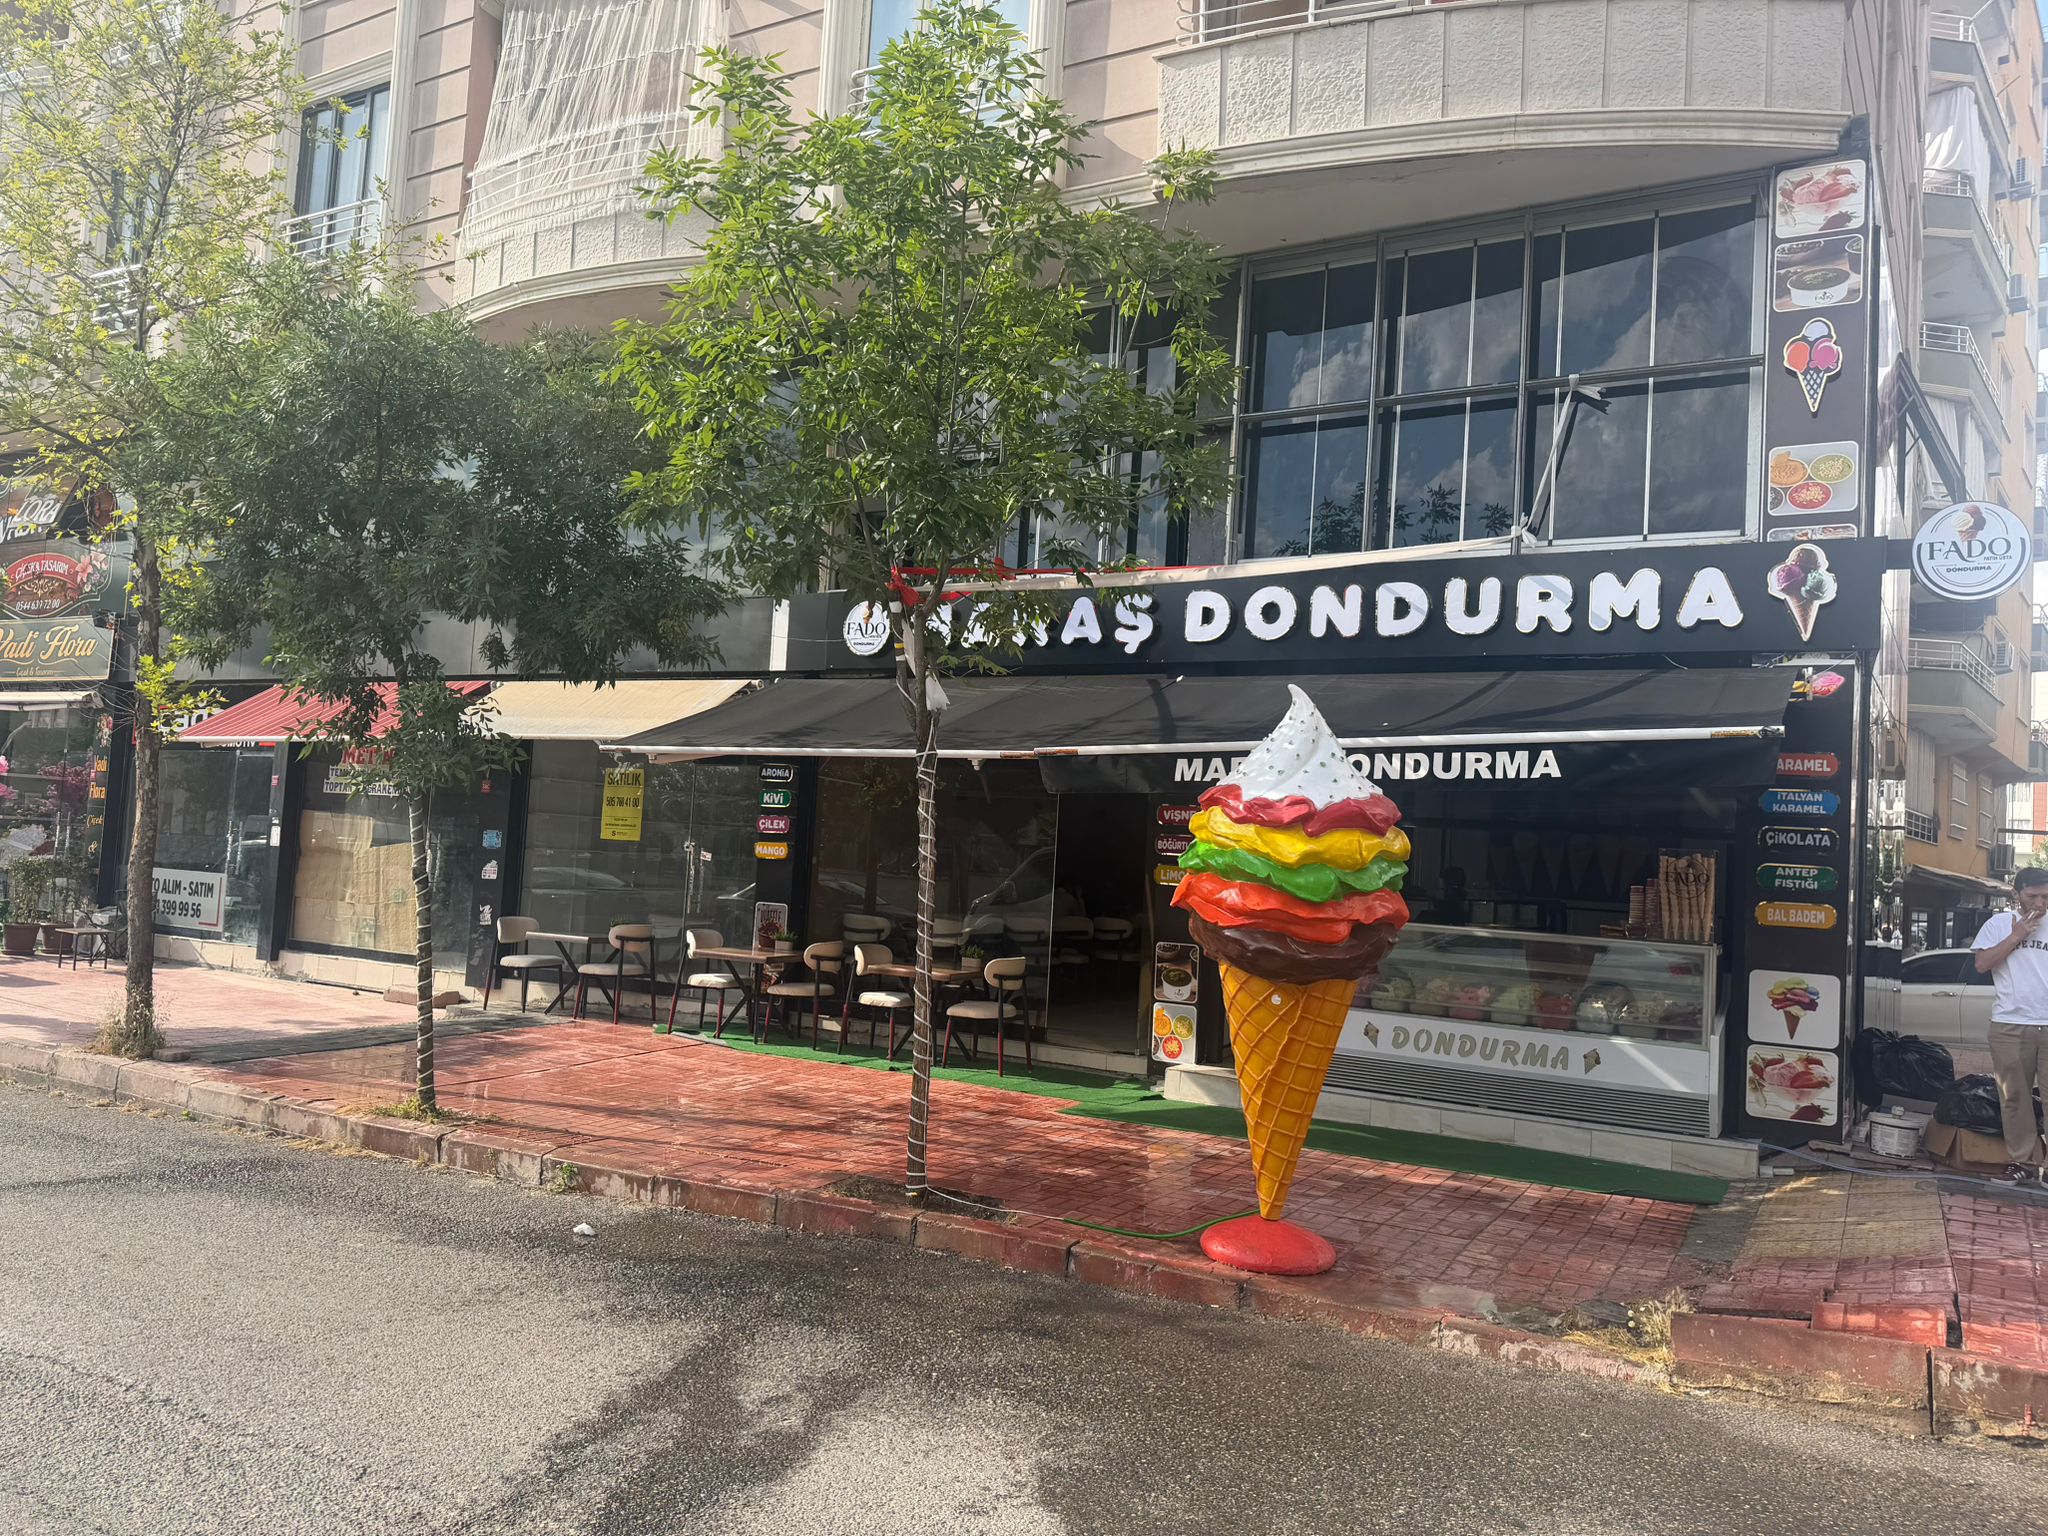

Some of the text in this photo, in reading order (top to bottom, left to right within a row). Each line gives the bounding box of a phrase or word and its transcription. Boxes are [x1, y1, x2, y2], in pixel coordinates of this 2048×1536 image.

[1926, 537, 2012, 563] FADO
[41, 560, 68, 575] TASARIM
[1946, 565, 1992, 573] DONDURMA
[1184, 566, 1743, 642] DONDURMA
[846, 622, 887, 638] FADO
[40, 624, 98, 660] Flora
[1348, 750, 1562, 780] ONDURMA
[1776, 758, 1831, 772] ARAMEL
[607, 772, 642, 786] SATILIK
[90, 782, 106, 799] Flora
[1772, 803, 1827, 814] KARAMEL
[755, 845, 785, 856] MANGO
[1665, 871, 1710, 887] FADO
[1776, 867, 1818, 877] ANTEP
[161, 879, 182, 895] ALIM
[188, 881, 214, 898] SATIM
[1774, 878, 1819, 890] FISTIĞI
[161, 900, 177, 916] 399
[178, 901, 190, 917] 99
[190, 902, 202, 919] 56
[1767, 908, 1826, 924] BAL BADEM
[1391, 1026, 1569, 1070] DONDURMA
